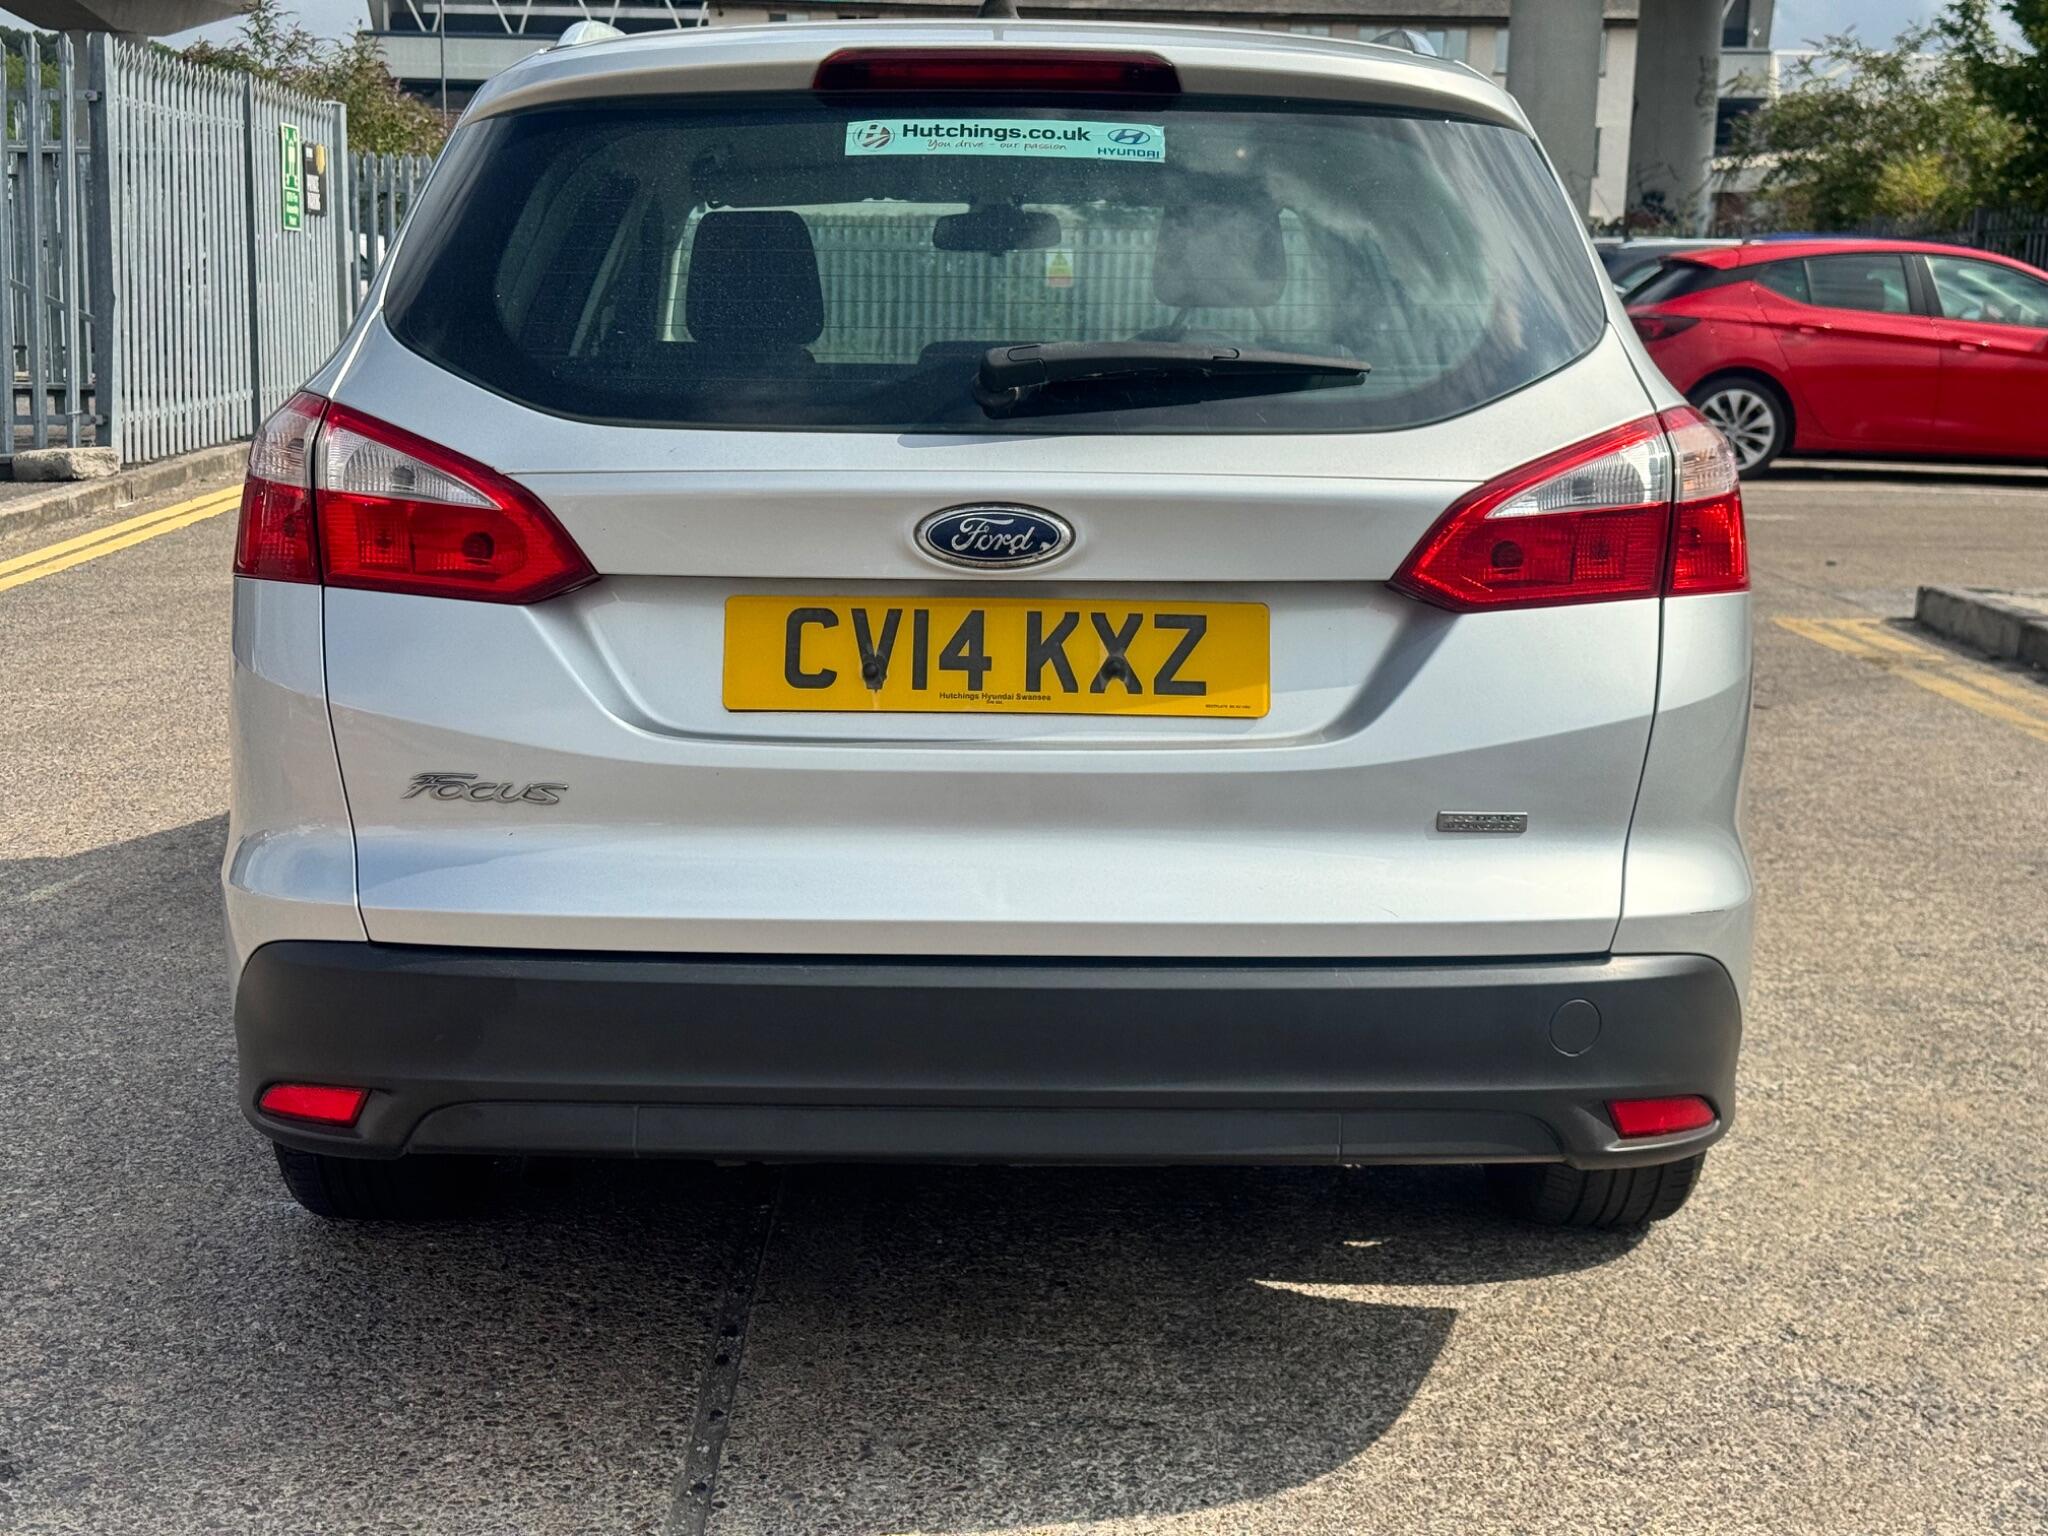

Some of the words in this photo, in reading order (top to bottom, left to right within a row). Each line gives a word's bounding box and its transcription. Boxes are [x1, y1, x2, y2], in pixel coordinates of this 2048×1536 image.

[902, 123, 1090, 142] Hutchings.co.uk
[927, 138, 951, 151] You
[955, 139, 984, 149] drive
[1023, 142, 1067, 151] passion
[1097, 147, 1160, 159] HYUNDAI
[951, 517, 1036, 555] Ford
[784, 607, 992, 692] CV14
[1025, 610, 1208, 697] KXZ
[940, 692, 979, 700] Hutchings
[981, 692, 1014, 701] Hyundai
[1016, 693, 1051, 701] Swansea
